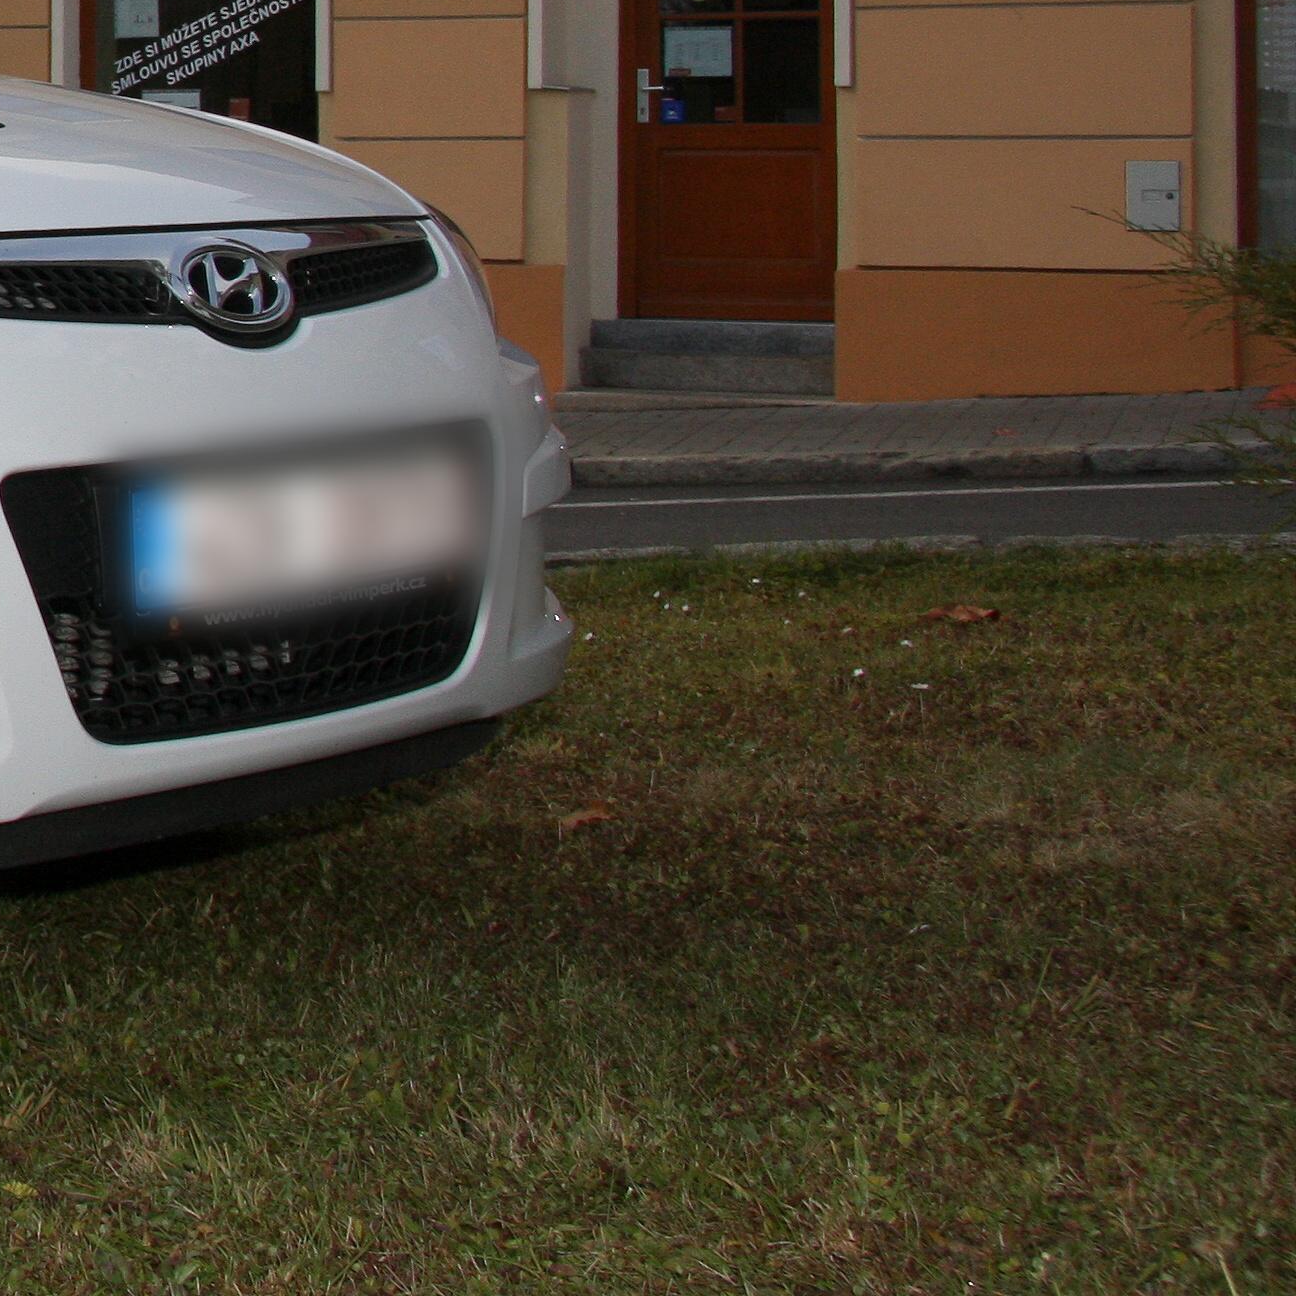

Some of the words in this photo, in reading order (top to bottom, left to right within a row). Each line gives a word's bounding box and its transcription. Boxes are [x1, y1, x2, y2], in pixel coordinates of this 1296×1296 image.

[112, 54, 178, 95] SMLOUVU
[181, 40, 202, 60] SE
[114, 50, 144, 75] ZDE
[145, 42, 160, 59] SI
[166, 50, 227, 86] SKUPINY
[229, 31, 261, 56] AXA
